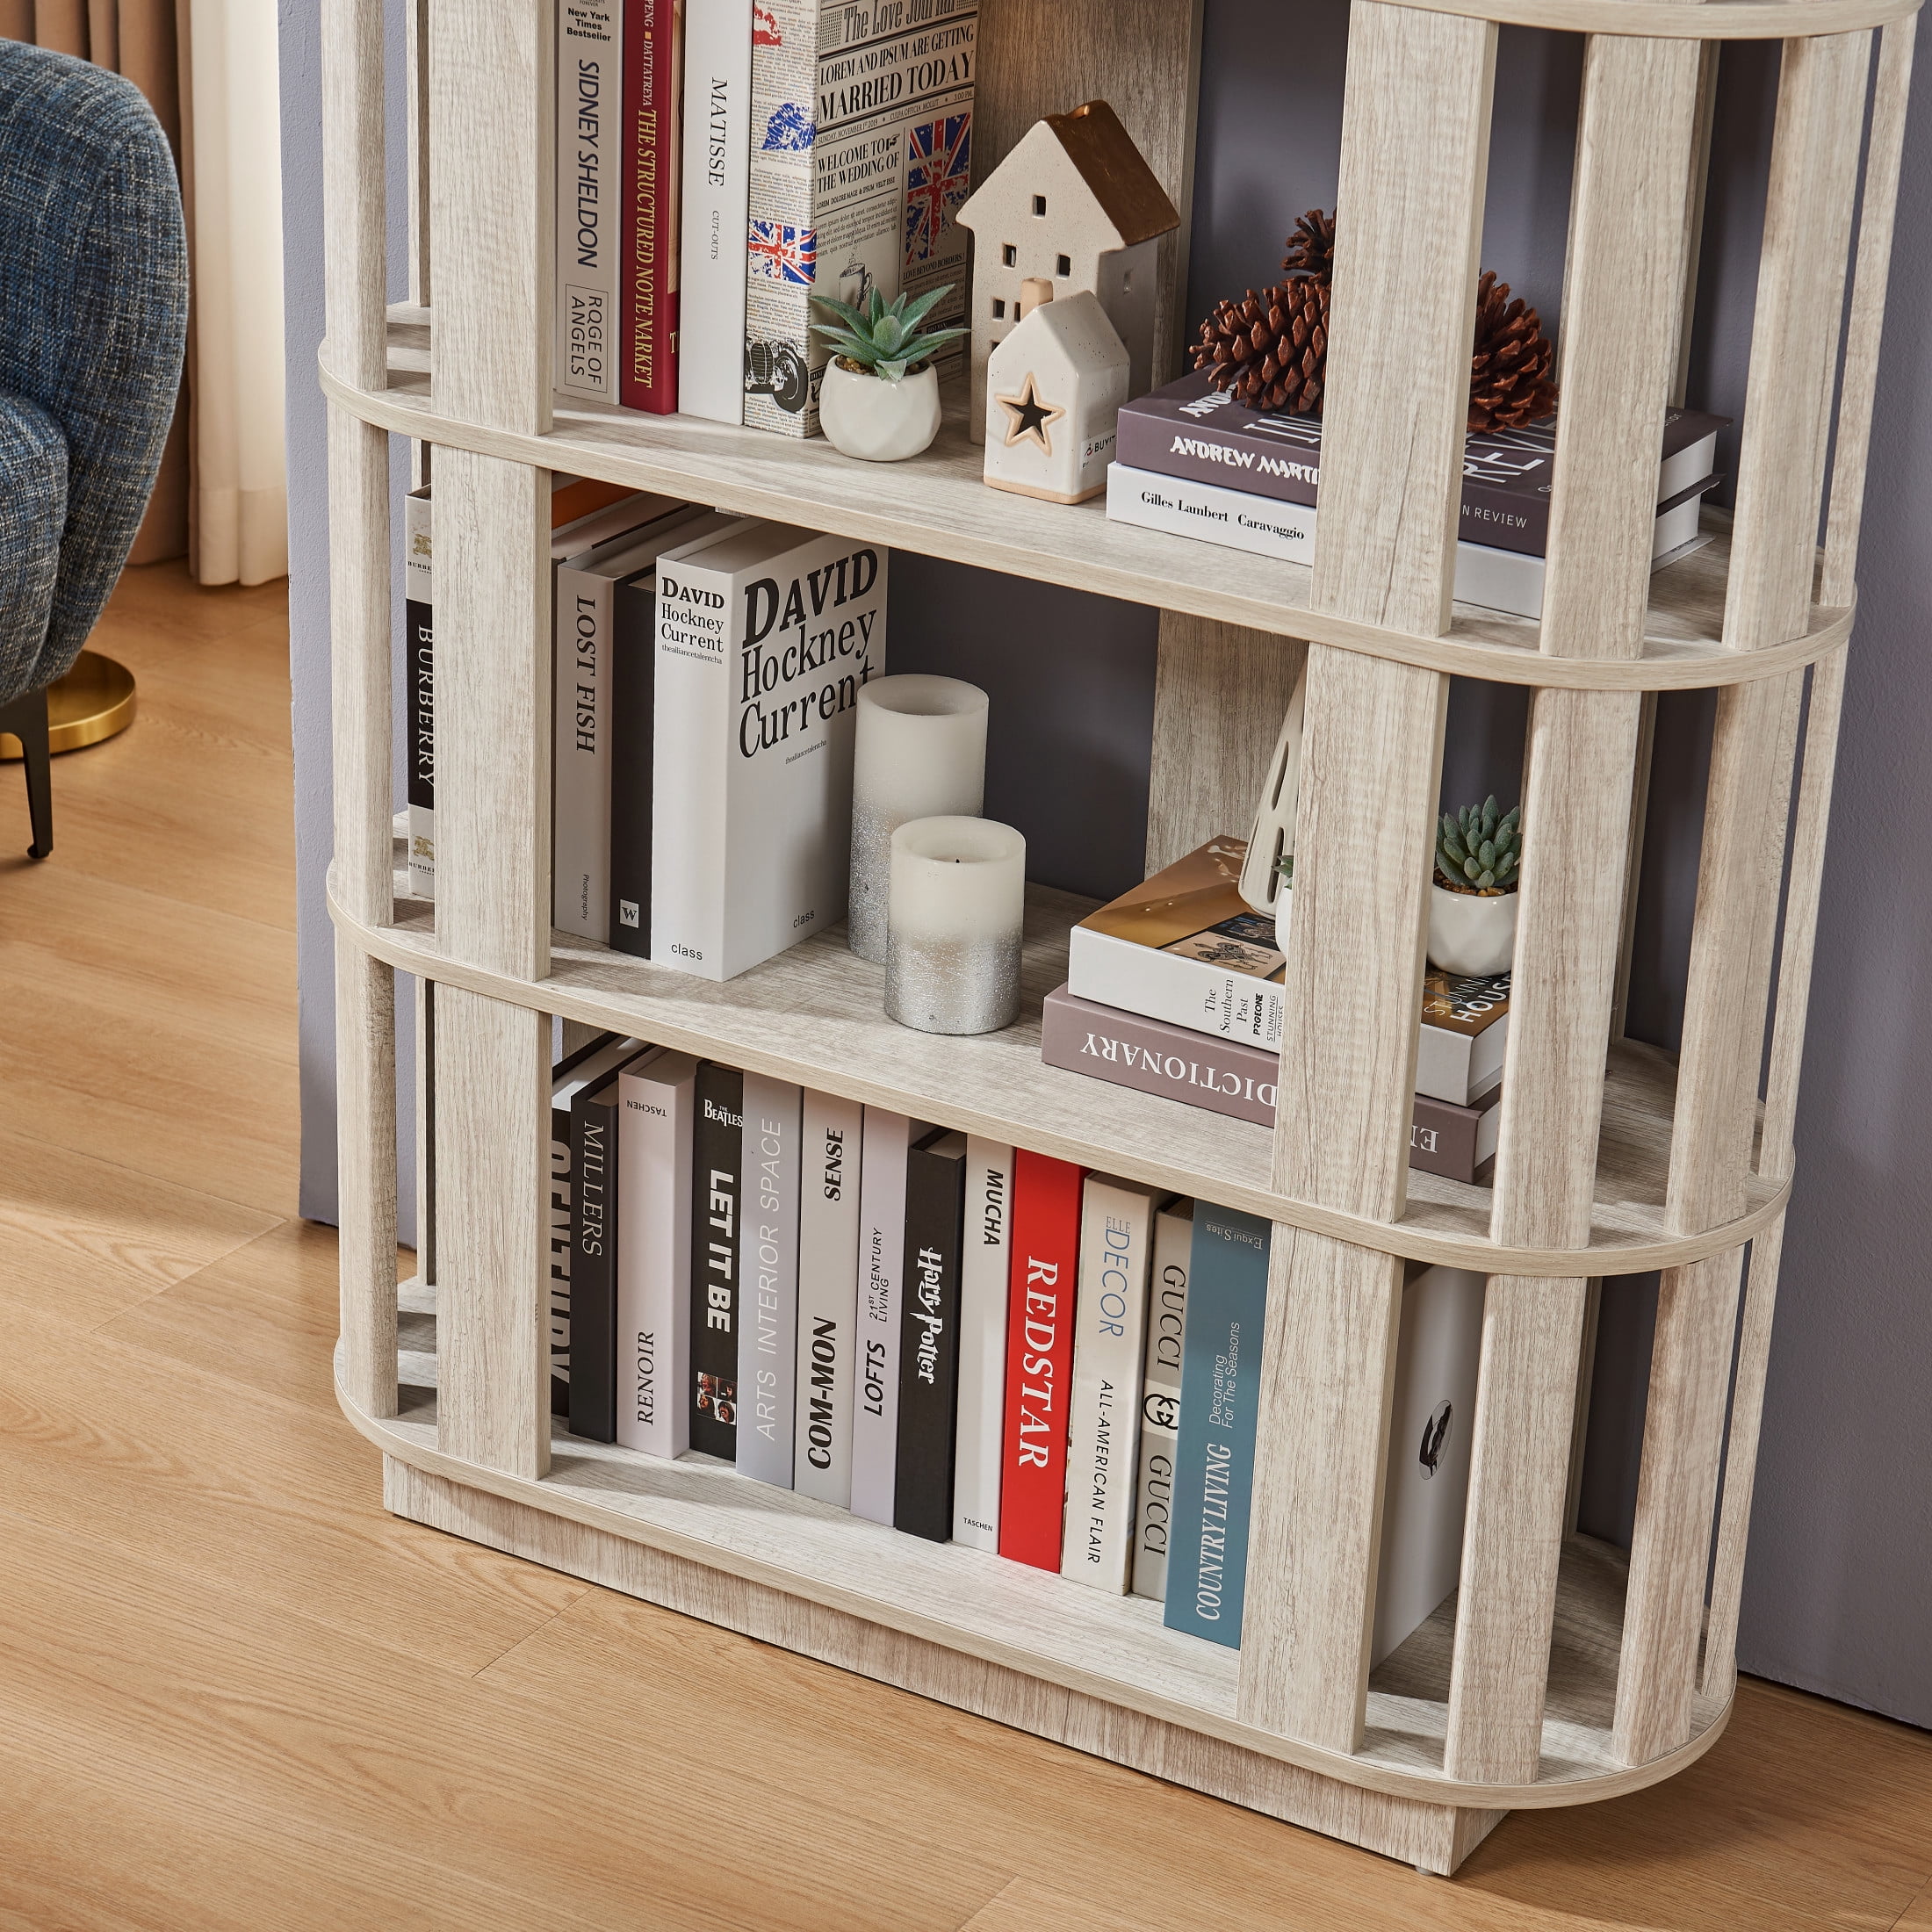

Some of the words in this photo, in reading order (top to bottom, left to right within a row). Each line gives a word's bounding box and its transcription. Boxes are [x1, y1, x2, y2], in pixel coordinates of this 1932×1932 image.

[568, 8, 588, 18] New
[575, 18, 602, 31] Times
[844, 4, 869, 43] The
[872, 0, 903, 36] Love
[643, 40, 653, 106] DATTATREYA
[819, 70, 903, 125] MARRIED
[907, 49, 975, 94] TODAY
[820, 58, 855, 86] LOREM
[856, 52, 878, 76] AND
[879, 44, 909, 68] IPSUM
[909, 35, 930, 60] ARE
[931, 24, 975, 52] GETTING
[578, 59, 600, 149] SIDNEY
[638, 109, 657, 145] THE
[708, 76, 728, 187] MATISSE
[817, 143, 869, 174] WELCOME
[869, 138, 885, 155] TO
[817, 172, 837, 194] THE
[839, 157, 884, 186] WEDDING
[886, 151, 901, 170] OF
[577, 155, 599, 269] SHELDON
[635, 145, 656, 262] STRUCTURED
[710, 210, 720, 261] CUT-OUTS
[635, 265, 655, 315] NOTE
[571, 295, 586, 376] ANGELS
[588, 357, 602, 385] OF
[1170, 436, 1256, 469] ANDREW
[1257, 455, 1319, 486] MARTI
[1474, 507, 1527, 529] REVIEW
[1141, 490, 1174, 509] Gilles
[1178, 499, 1229, 523] Lambert
[1237, 513, 1306, 541] Caravaggio
[661, 576, 725, 609] DAVID
[661, 602, 724, 635] Hockney
[742, 548, 878, 650] DAVID
[576, 594, 597, 677] LOST
[661, 623, 724, 653] Current
[740, 609, 877, 704] Hockney
[576, 683, 596, 755] FISH
[739, 654, 876, 759] Current
[581, 874, 590, 921] Photography
[622, 906, 638, 921] W
[793, 909, 815, 929] class
[671, 942, 703, 961] class
[1204, 989, 1217, 1013] The
[1219, 979, 1234, 1034] Southern
[1236, 998, 1249, 1023] Past
[1266, 995, 1277, 1042] STUNNING
[1079, 1031, 1280, 1107] DICTIONARY
[626, 1099, 667, 1117] TASCHEN
[581, 1121, 605, 1257] MILLERS
[760, 1118, 782, 1213] SPACE
[709, 1169, 734, 1238] LET
[983, 1168, 1005, 1246] MUCHA
[1106, 1215, 1131, 1234] ELLE
[709, 1242, 732, 1280] IT
[757, 1223, 779, 1355] INTERIOR
[870, 1227, 883, 1291] CENTURY
[917, 1246, 943, 1315] Harry
[1098, 1229, 1130, 1337] DECOR
[707, 1283, 732, 1333] BE
[807, 1316, 838, 1470] COM-MON
[824, 1127, 844, 1201] SENSE
[877, 1278, 890, 1323] LIVING
[1157, 1264, 1186, 1372] GUCCI
[638, 1330, 655, 1426] RENOIR
[863, 1339, 886, 1417] LOFTS
[909, 1311, 943, 1386] Potter
[1017, 1255, 1059, 1470] REDSTAR
[1225, 1322, 1240, 1377] Seasons
[756, 1369, 777, 1442] ARTS
[1208, 1354, 1228, 1424] Decorating
[1222, 1380, 1236, 1402] The
[1222, 1407, 1234, 1429] For
[1087, 1379, 1114, 1511] ALL-AMERICAN
[1143, 1453, 1173, 1559] GUCCI
[1203, 1443, 1232, 1520] LIVING
[962, 1517, 993, 1532] TASCHEN
[1087, 1516, 1105, 1565] FLAIR
[1195, 1518, 1226, 1621] COUNTRY
